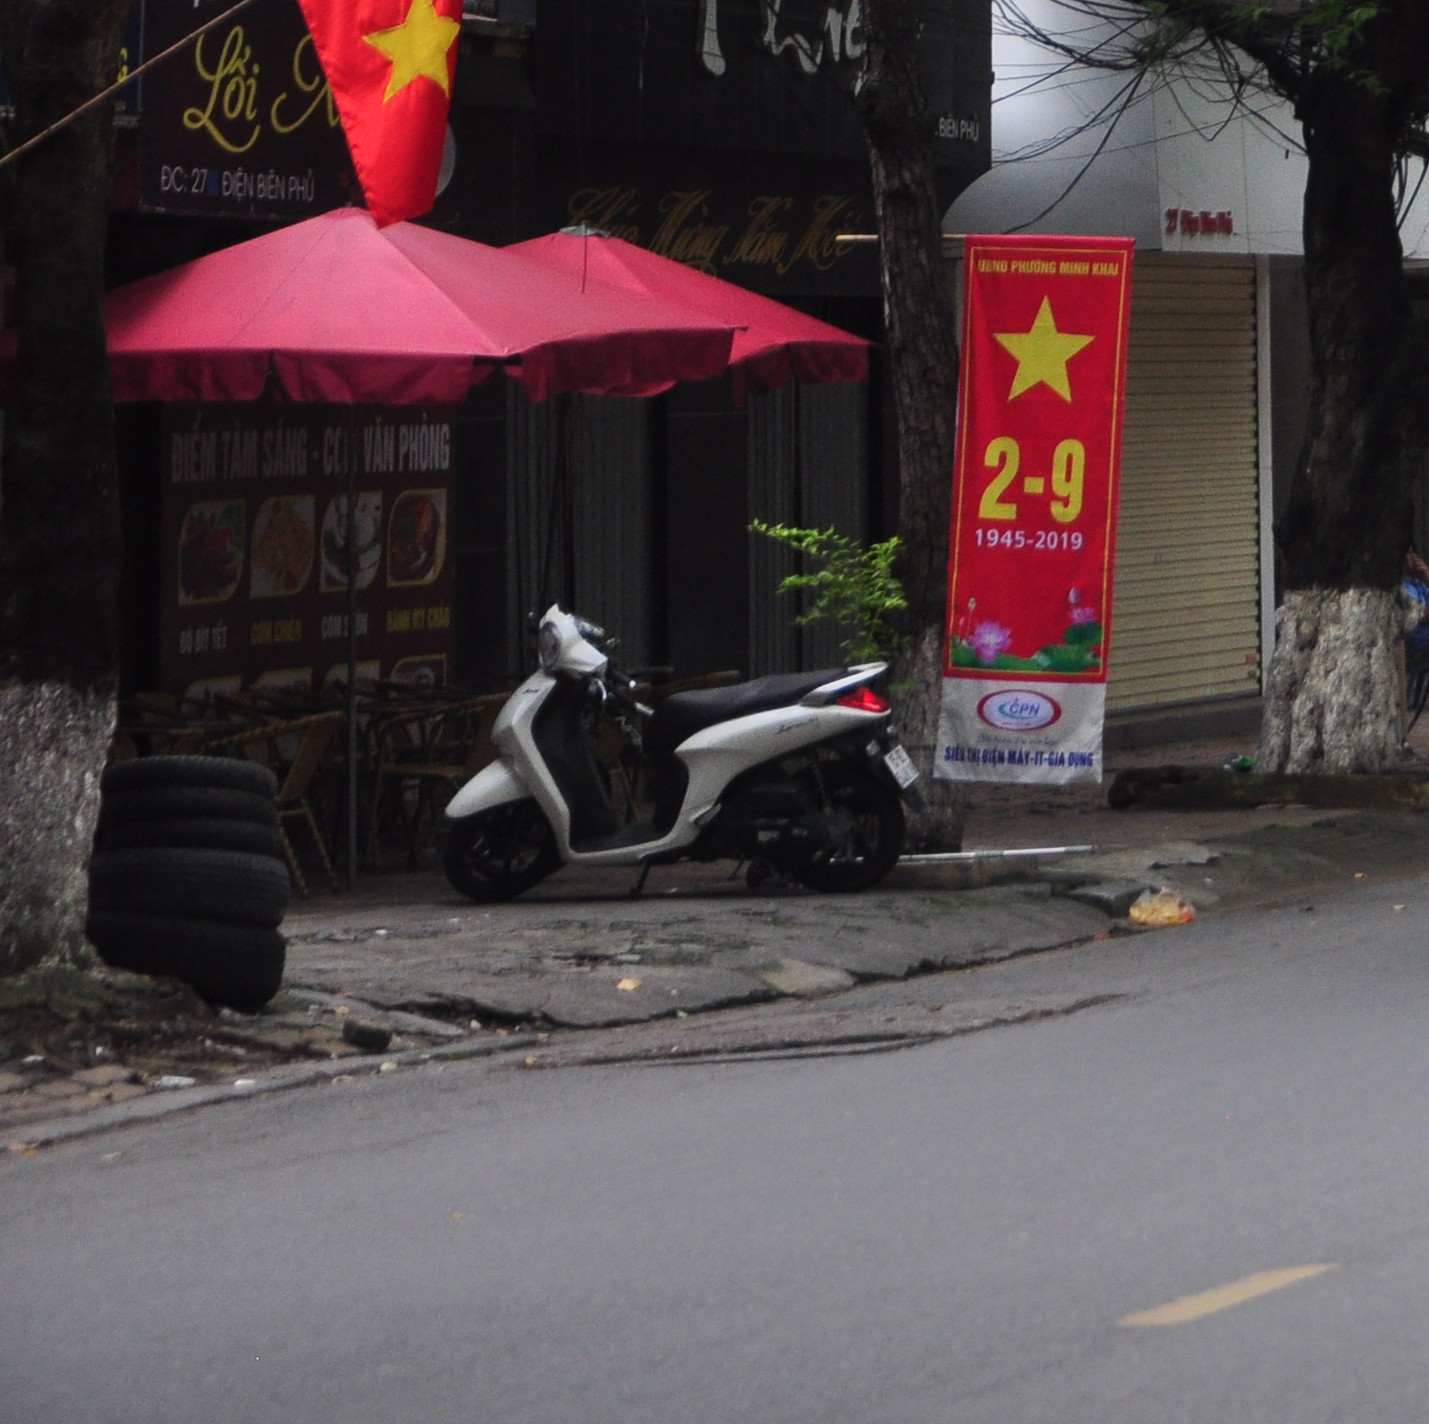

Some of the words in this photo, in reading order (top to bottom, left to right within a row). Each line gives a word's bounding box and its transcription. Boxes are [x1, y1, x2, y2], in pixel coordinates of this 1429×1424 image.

[191, 167, 208, 193] 27
[222, 166, 255, 202] ĐIỆN
[257, 168, 286, 200] BIÊN
[288, 167, 315, 203] PHỦ
[1060, 261, 1090, 275] MINH
[1092, 262, 1119, 276] KHAI
[977, 436, 1086, 523] 2-9
[974, 528, 1084, 551] 1945-2019
[1008, 698, 1040, 716] CPN
